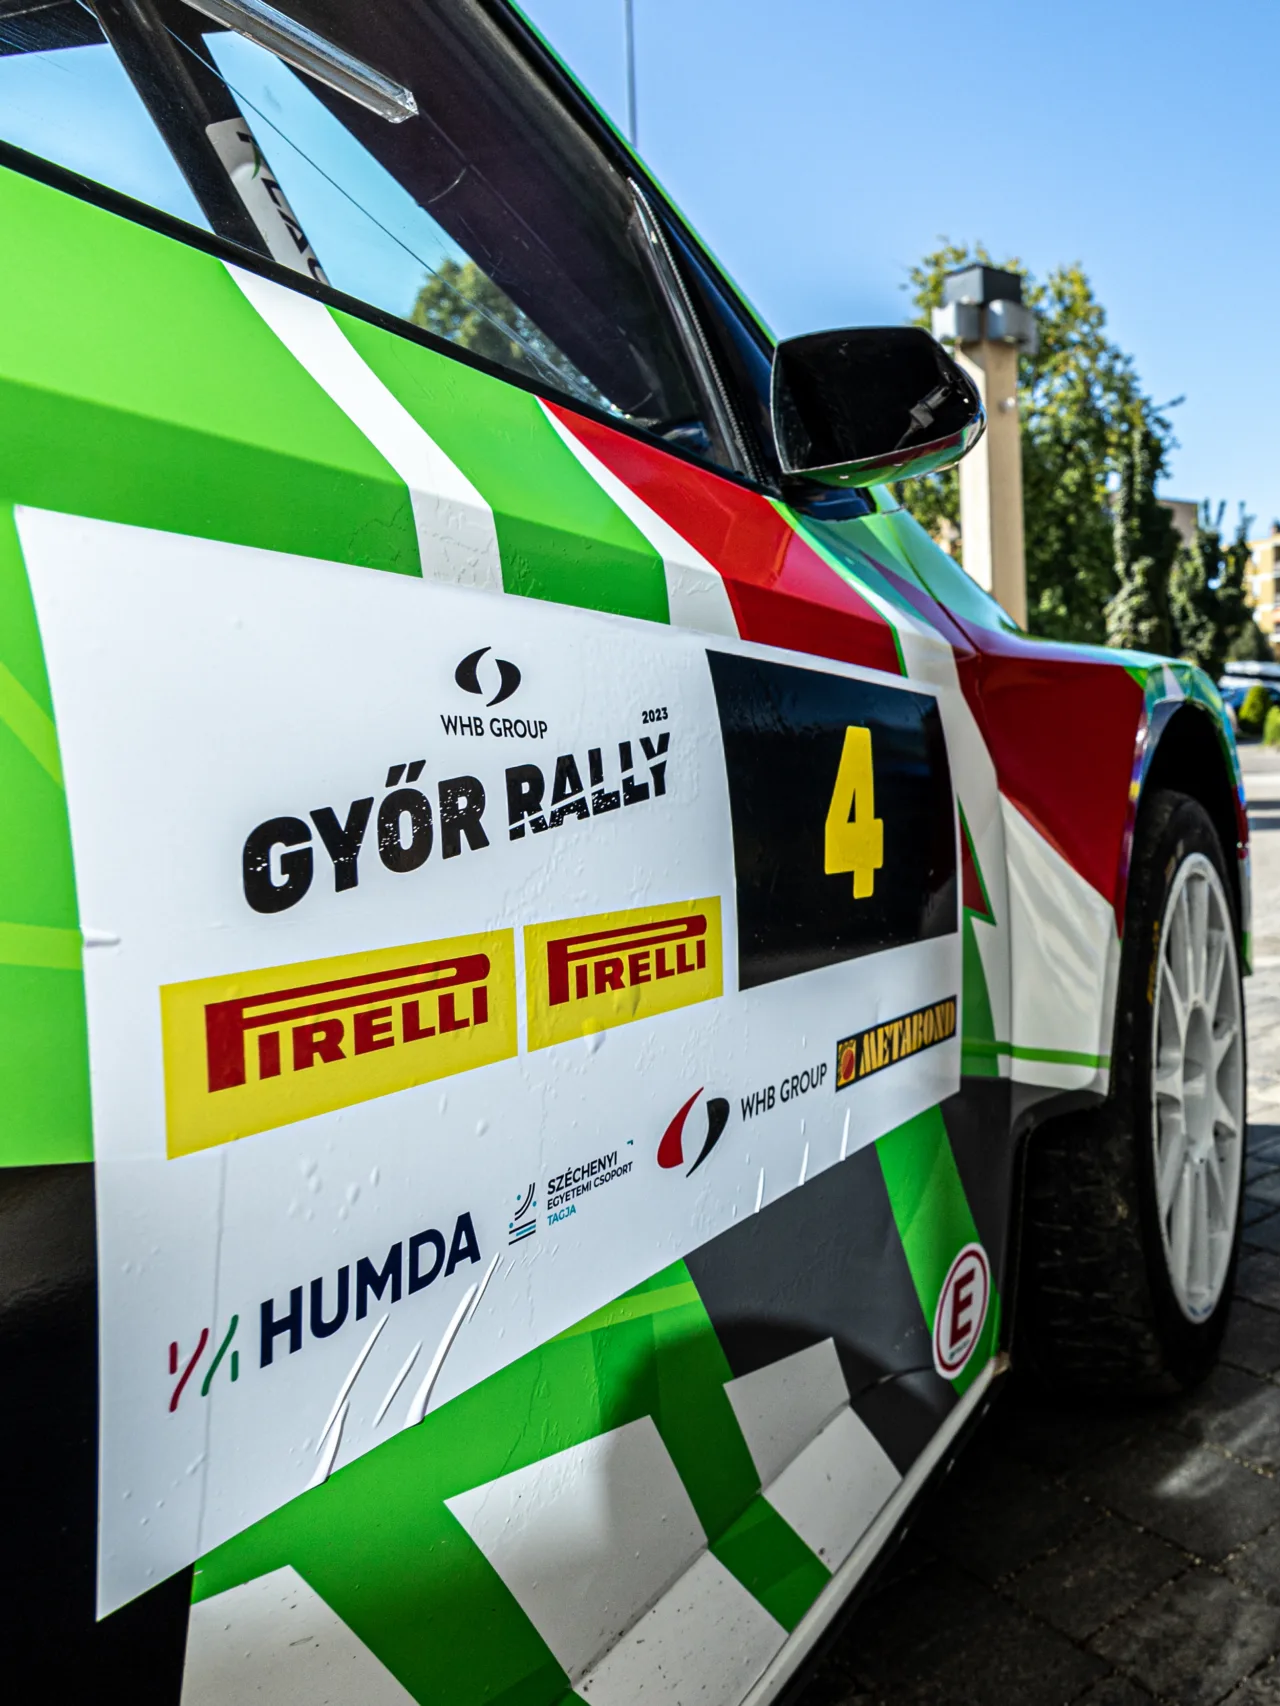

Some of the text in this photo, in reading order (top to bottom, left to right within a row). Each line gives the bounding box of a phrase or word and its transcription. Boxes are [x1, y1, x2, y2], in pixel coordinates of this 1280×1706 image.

[440, 714, 549, 740] WHB GROUP
[641, 706, 670, 725] 2023
[242, 731, 671, 915] GYŐR RALLY
[823, 725, 885, 900] 4
[546, 913, 708, 1007] PIRELLI
[204, 952, 491, 1094] PIRELLI
[859, 1001, 957, 1078] METABOND
[740, 1062, 828, 1122] WHB GROUP
[547, 1150, 618, 1195] SZÉCHENYI
[547, 1161, 634, 1211] EGYETEMI CSOPORT
[547, 1204, 577, 1226] TAGJA
[259, 1211, 482, 1369] HUMDA
[949, 1266, 976, 1350] E
